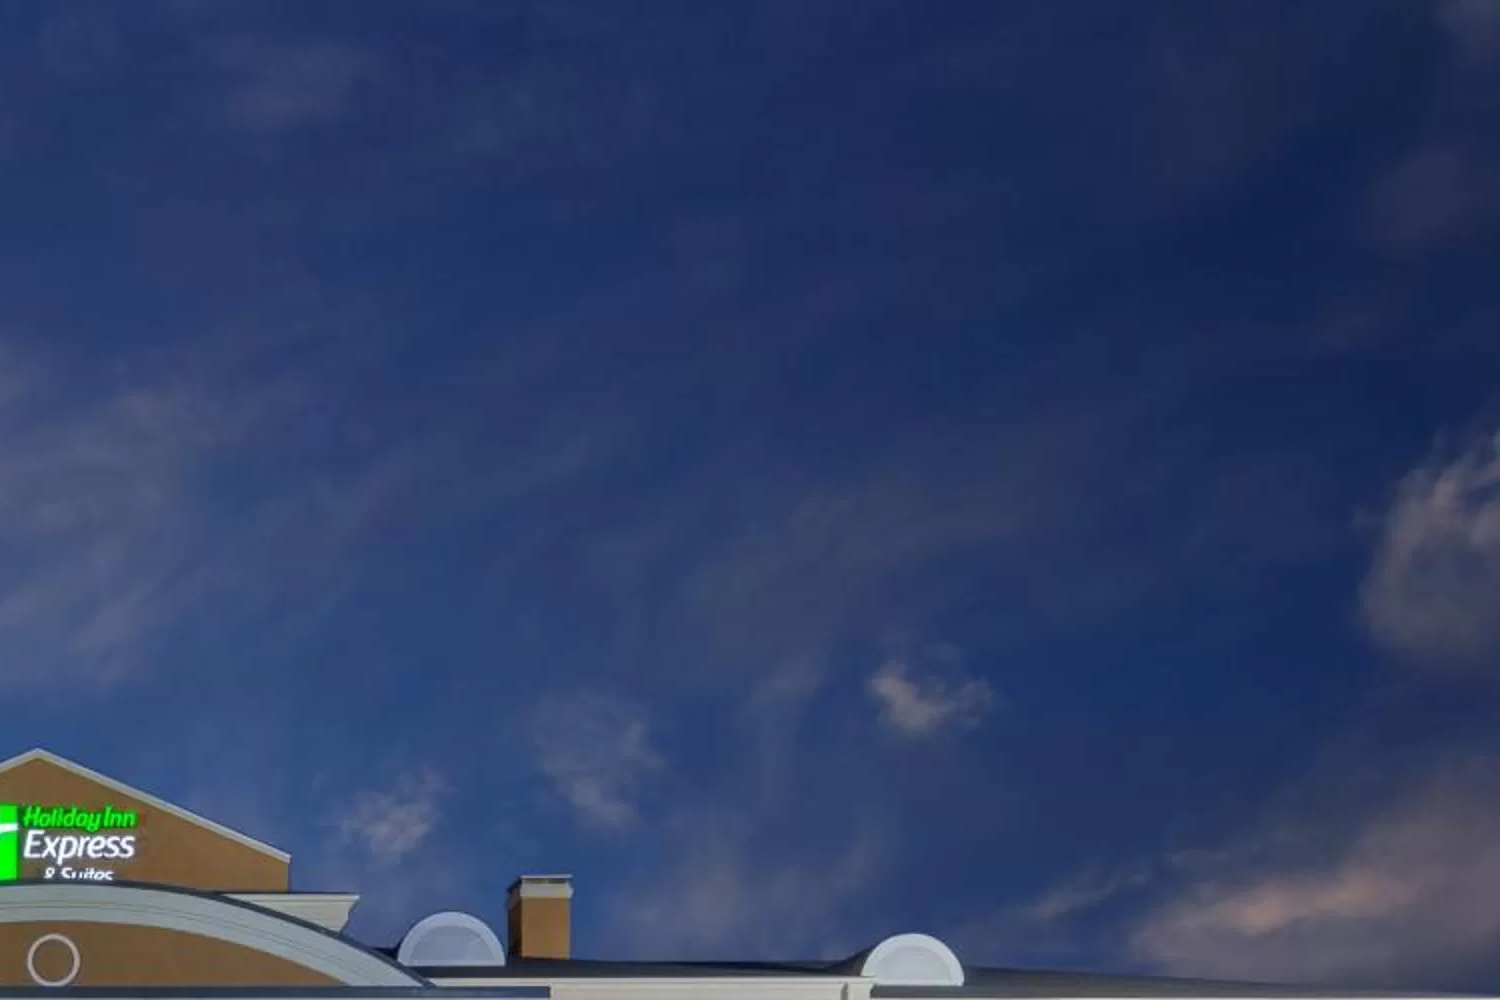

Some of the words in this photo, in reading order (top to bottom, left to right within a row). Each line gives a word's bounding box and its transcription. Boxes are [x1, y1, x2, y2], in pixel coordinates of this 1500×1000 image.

[23, 805, 101, 832] Holiday
[103, 804, 136, 828] Inn
[23, 829, 135, 865] Express
